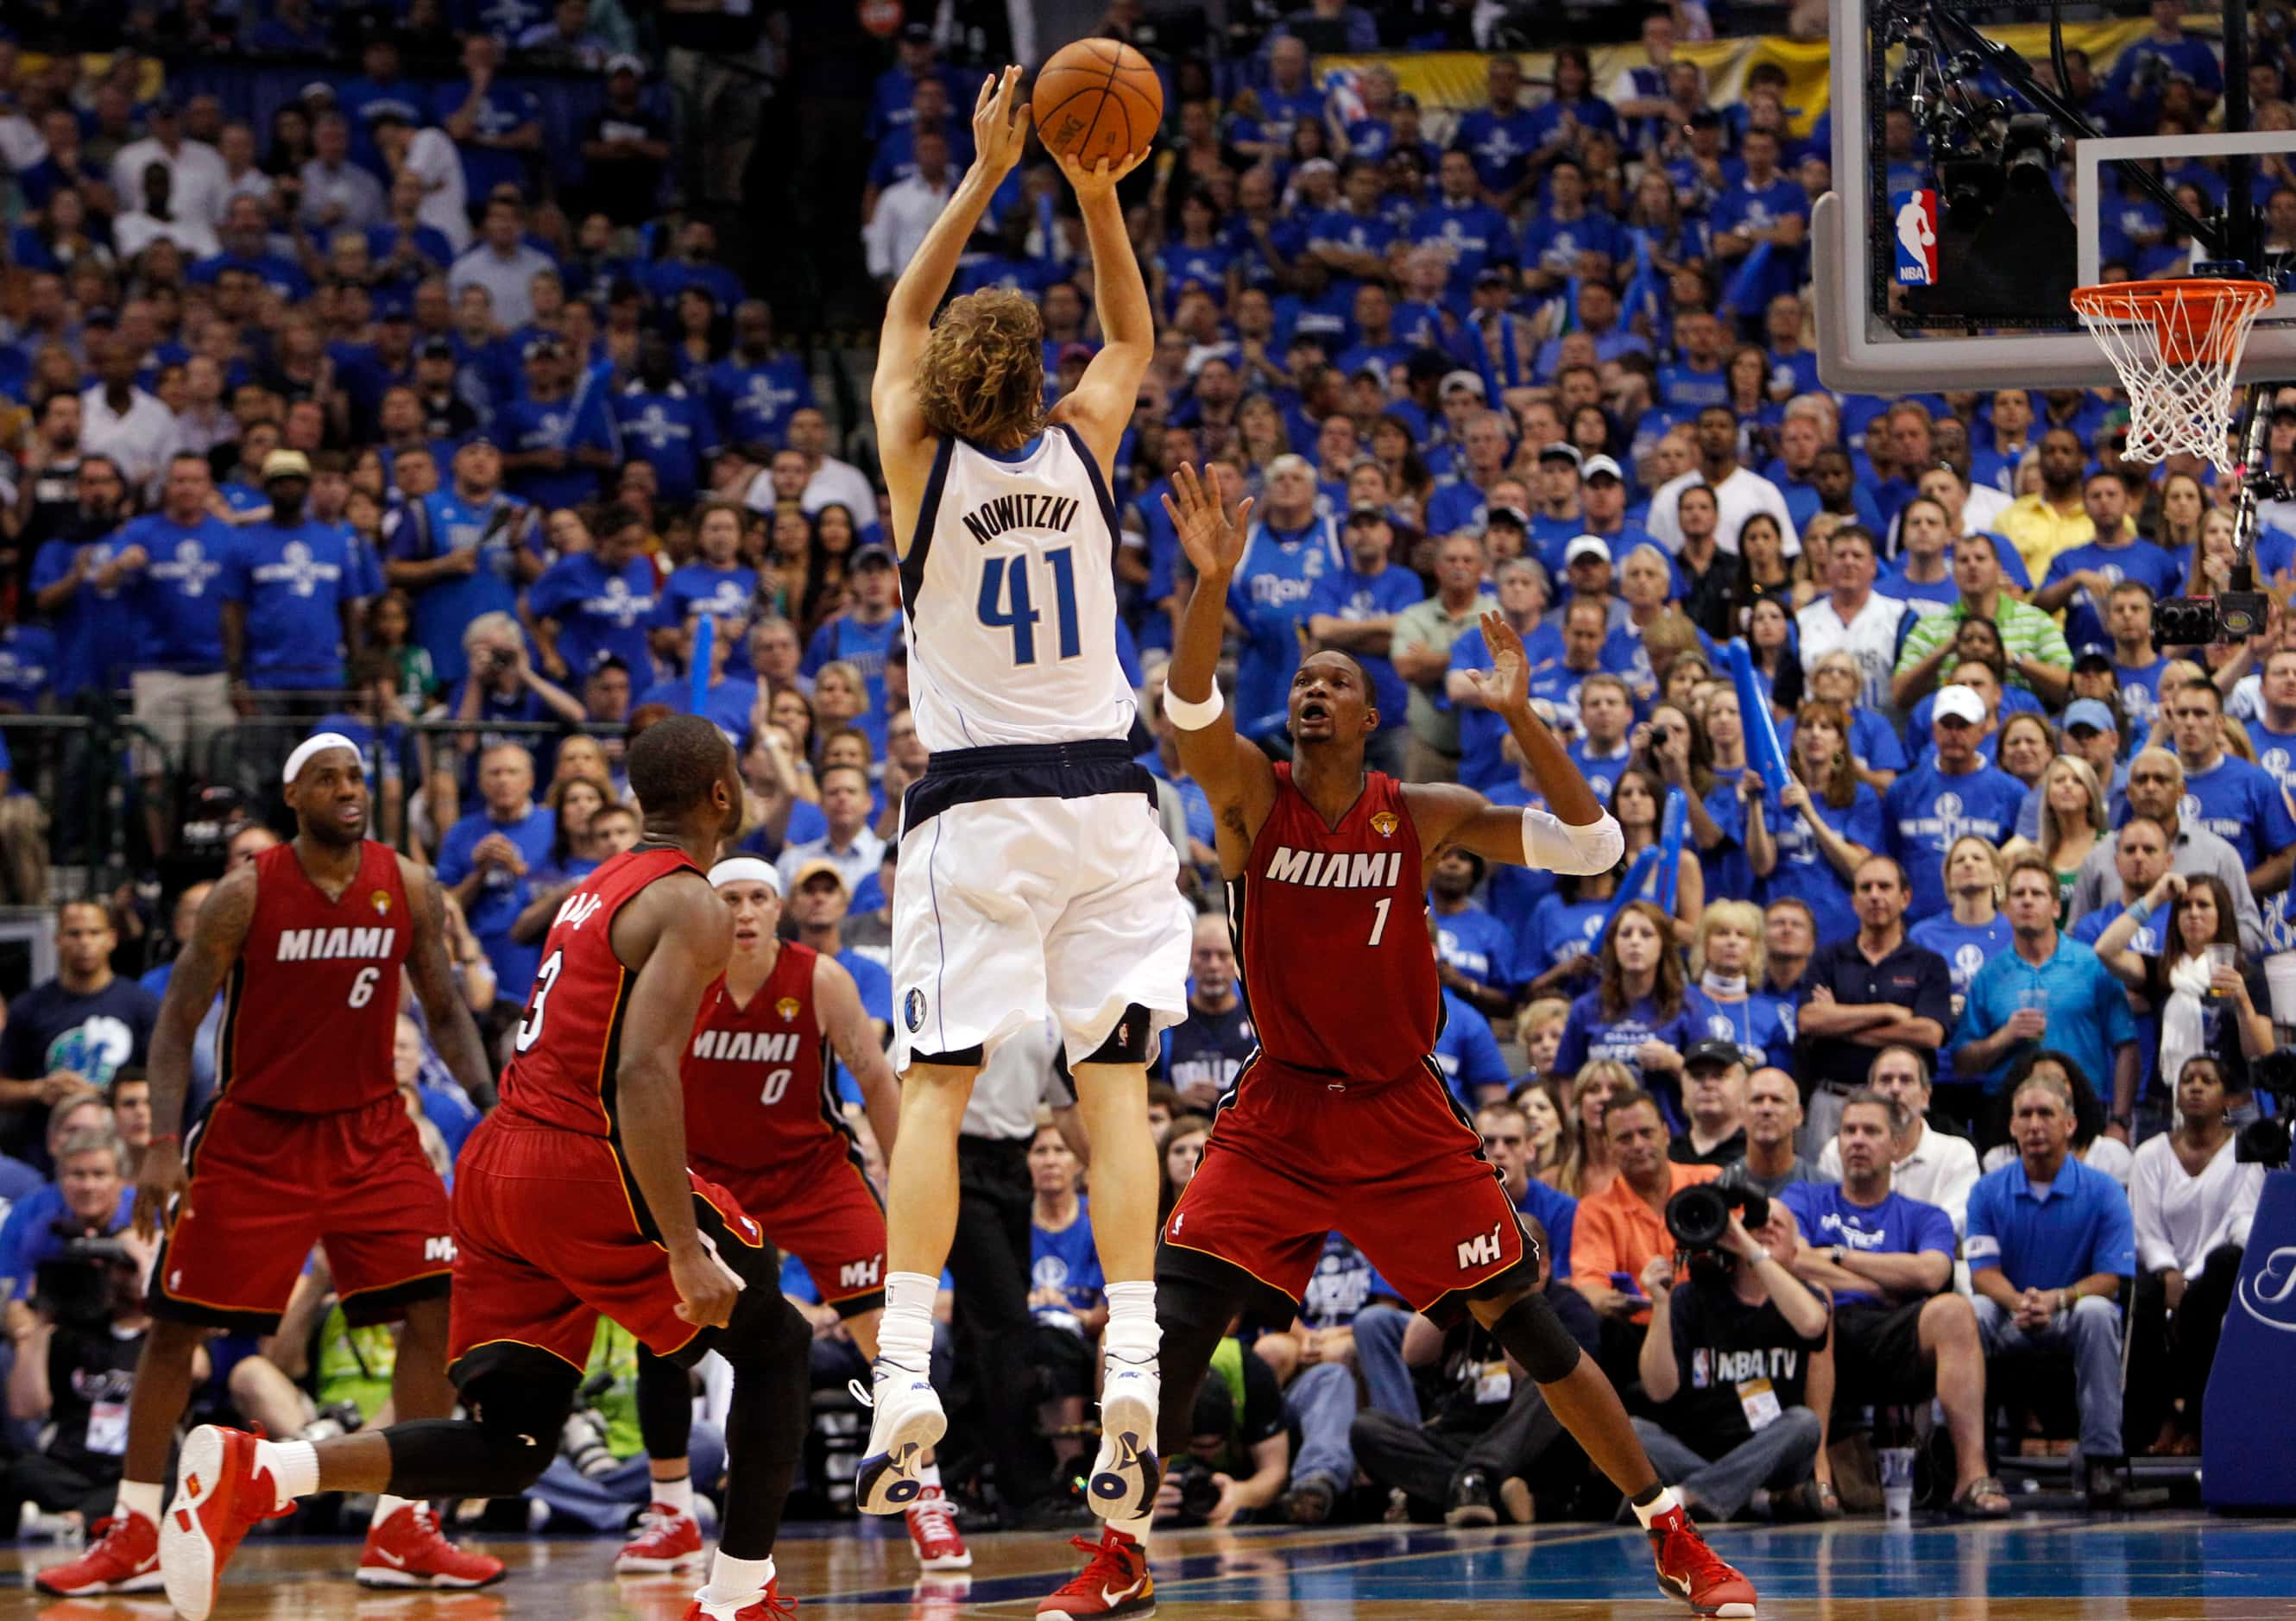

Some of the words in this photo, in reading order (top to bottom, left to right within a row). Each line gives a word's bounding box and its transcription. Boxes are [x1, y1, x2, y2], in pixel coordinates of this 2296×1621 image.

[1900, 266, 1924, 281] NBA
[962, 494, 1079, 545] NOWITZKI
[976, 546, 1082, 666] 41
[1264, 846, 1401, 887] MIAMI
[1366, 897, 1391, 946] 1
[277, 928, 395, 961] MIAMI
[348, 967, 380, 1008] 6
[515, 949, 564, 1054] 3
[693, 1029, 800, 1062] MIAMI
[760, 1068, 792, 1106] 0
[1718, 1349, 1766, 1381] NBA
[1769, 1347, 1797, 1380] TV
